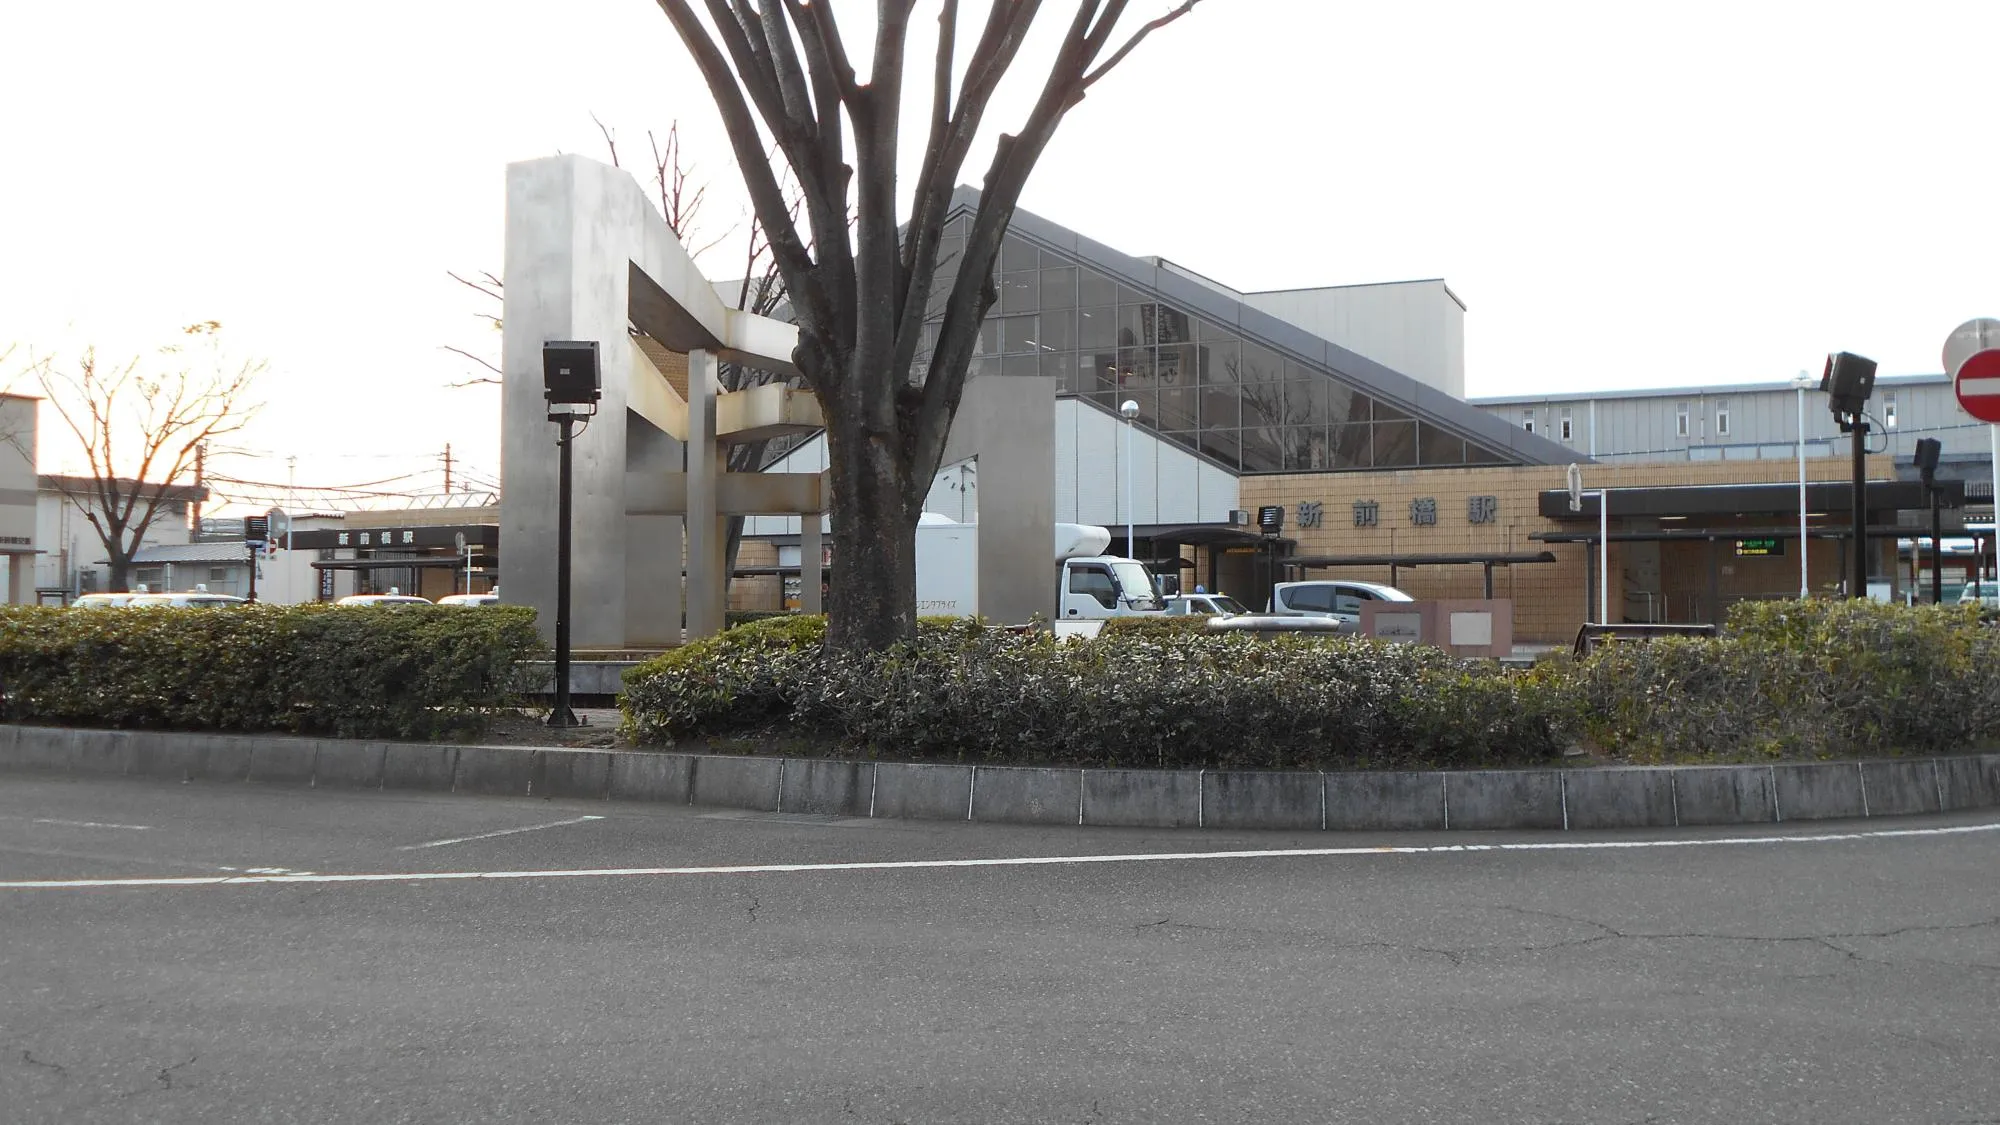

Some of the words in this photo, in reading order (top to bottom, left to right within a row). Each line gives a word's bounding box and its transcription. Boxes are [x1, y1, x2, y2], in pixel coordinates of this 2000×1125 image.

[1297, 496, 1497, 528] 新前橋駅
[338, 531, 414, 545] 新前橋駅
